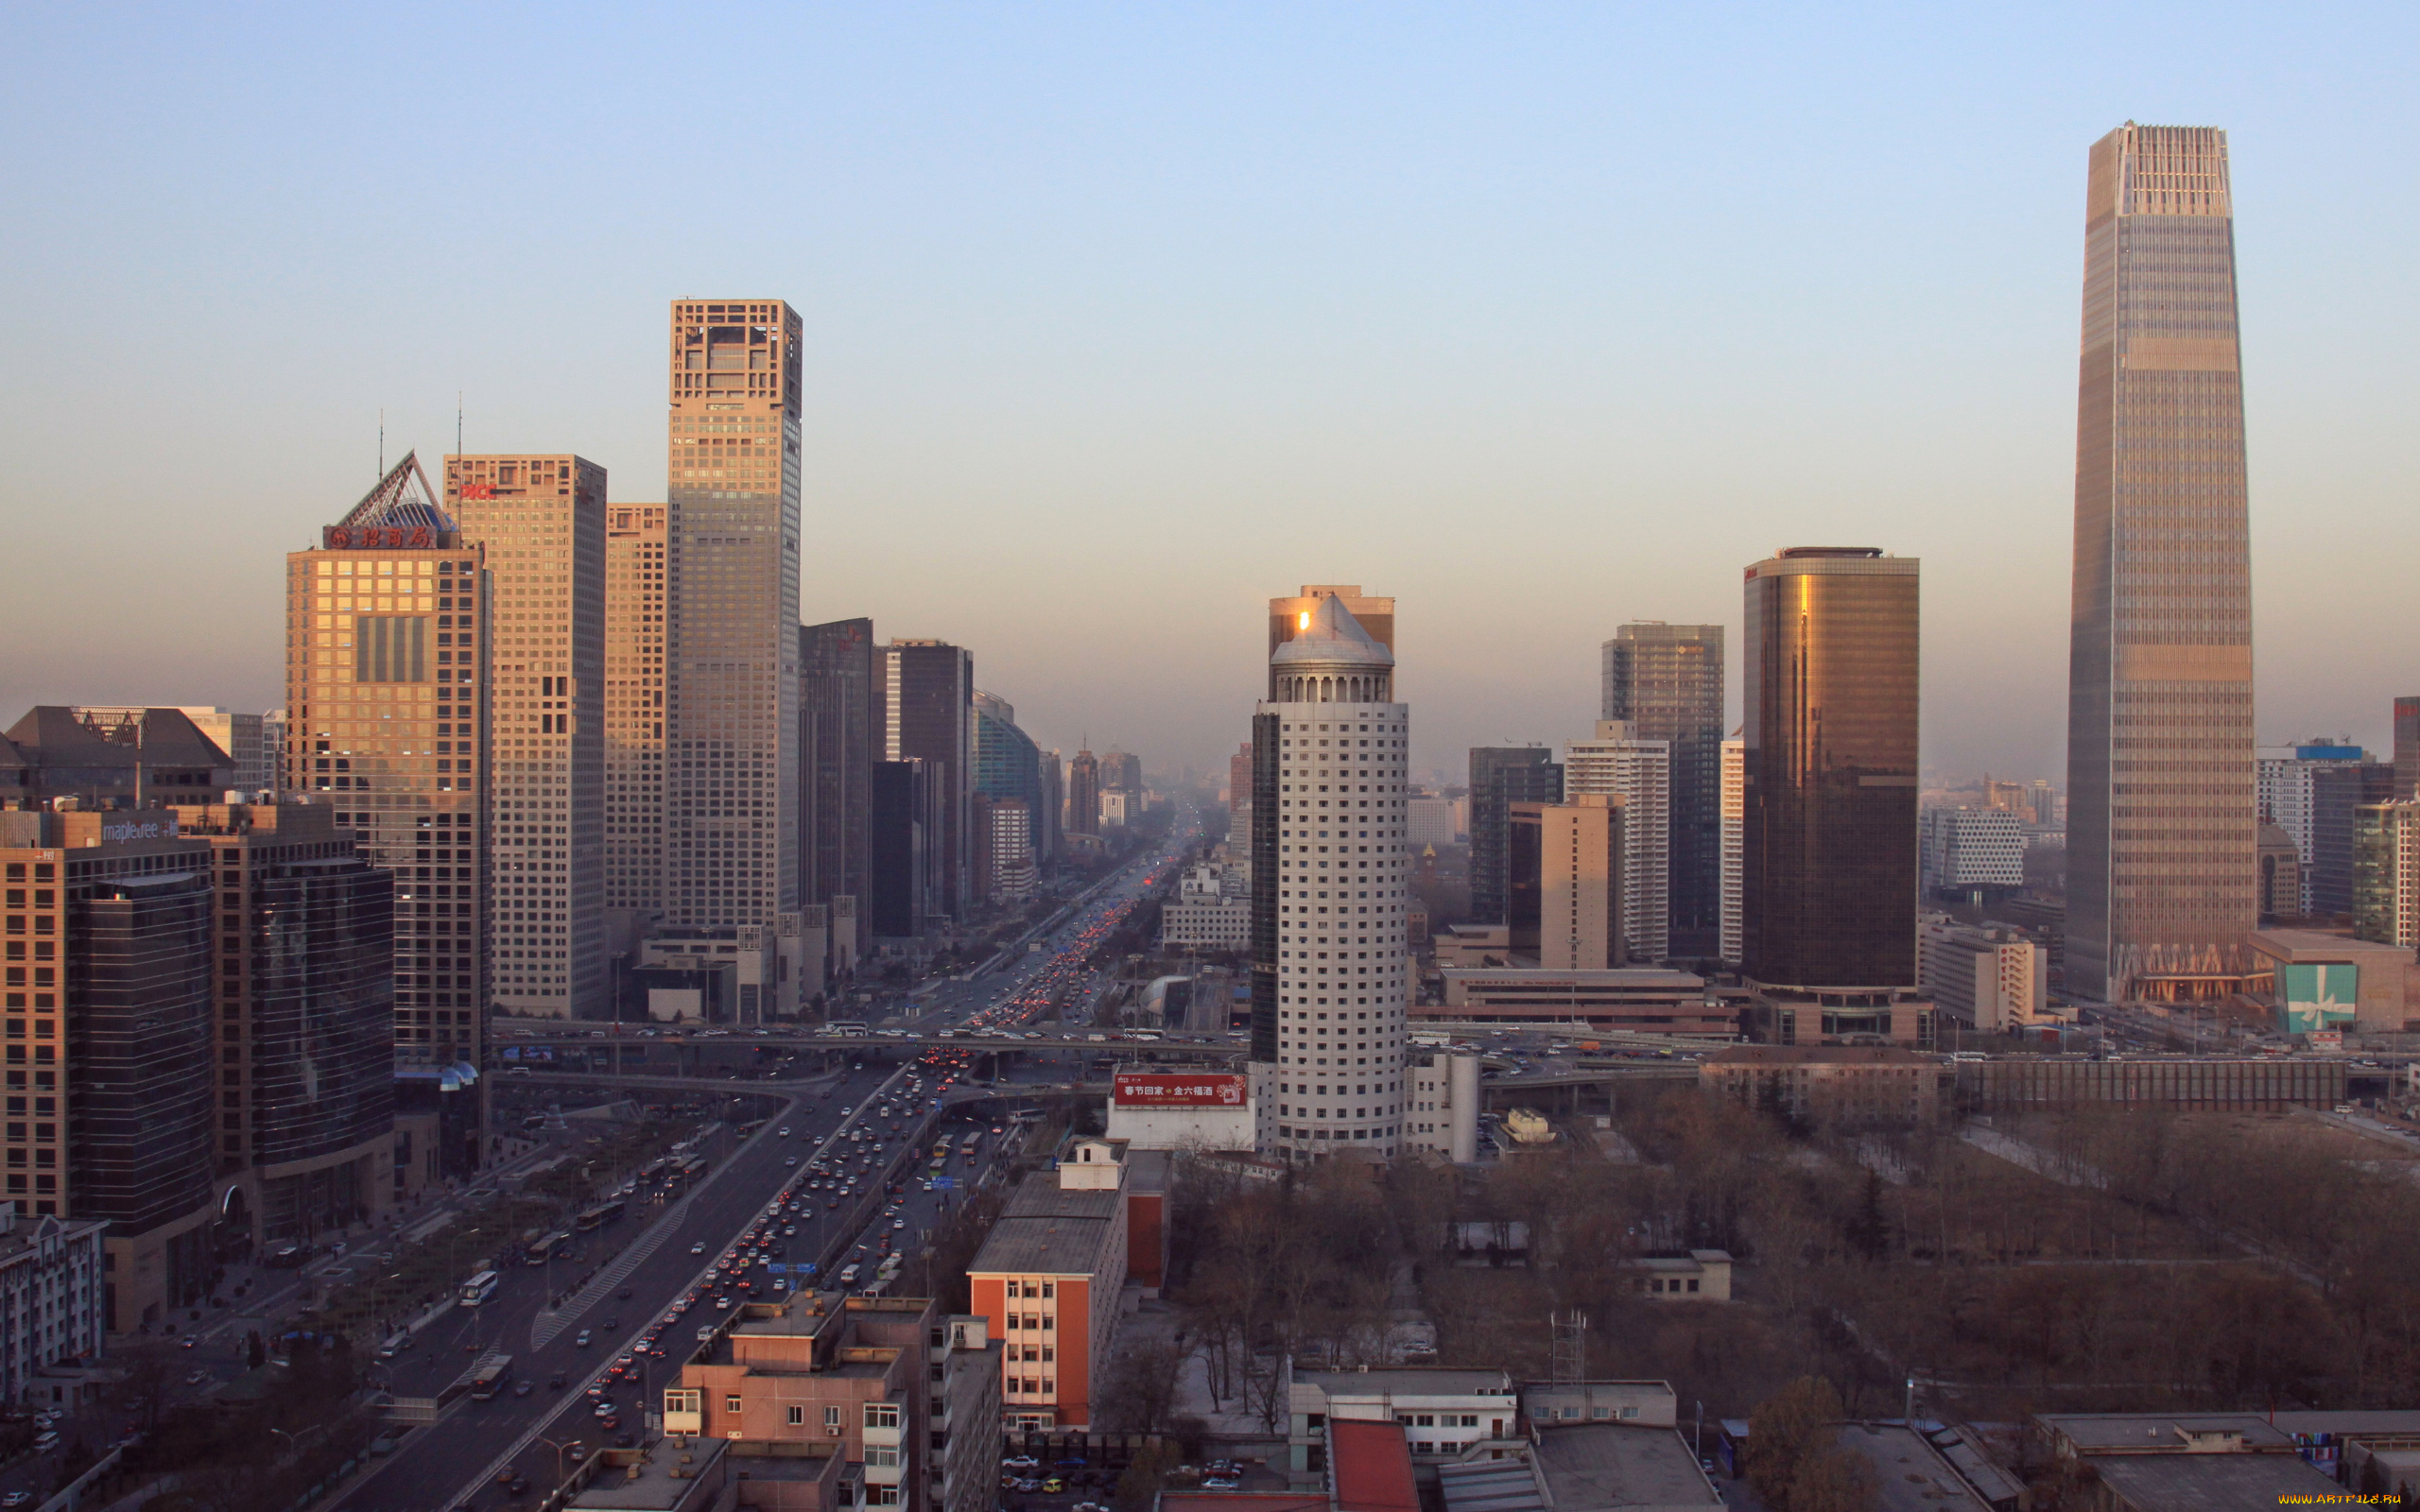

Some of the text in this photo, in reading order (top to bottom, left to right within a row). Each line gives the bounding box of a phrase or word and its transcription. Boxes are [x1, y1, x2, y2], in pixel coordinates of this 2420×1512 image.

[460, 483, 497, 501] PICC
[361, 526, 430, 547] 招商局
[103, 819, 158, 845] mapletree
[1124, 1086, 1164, 1096] 春节回家
